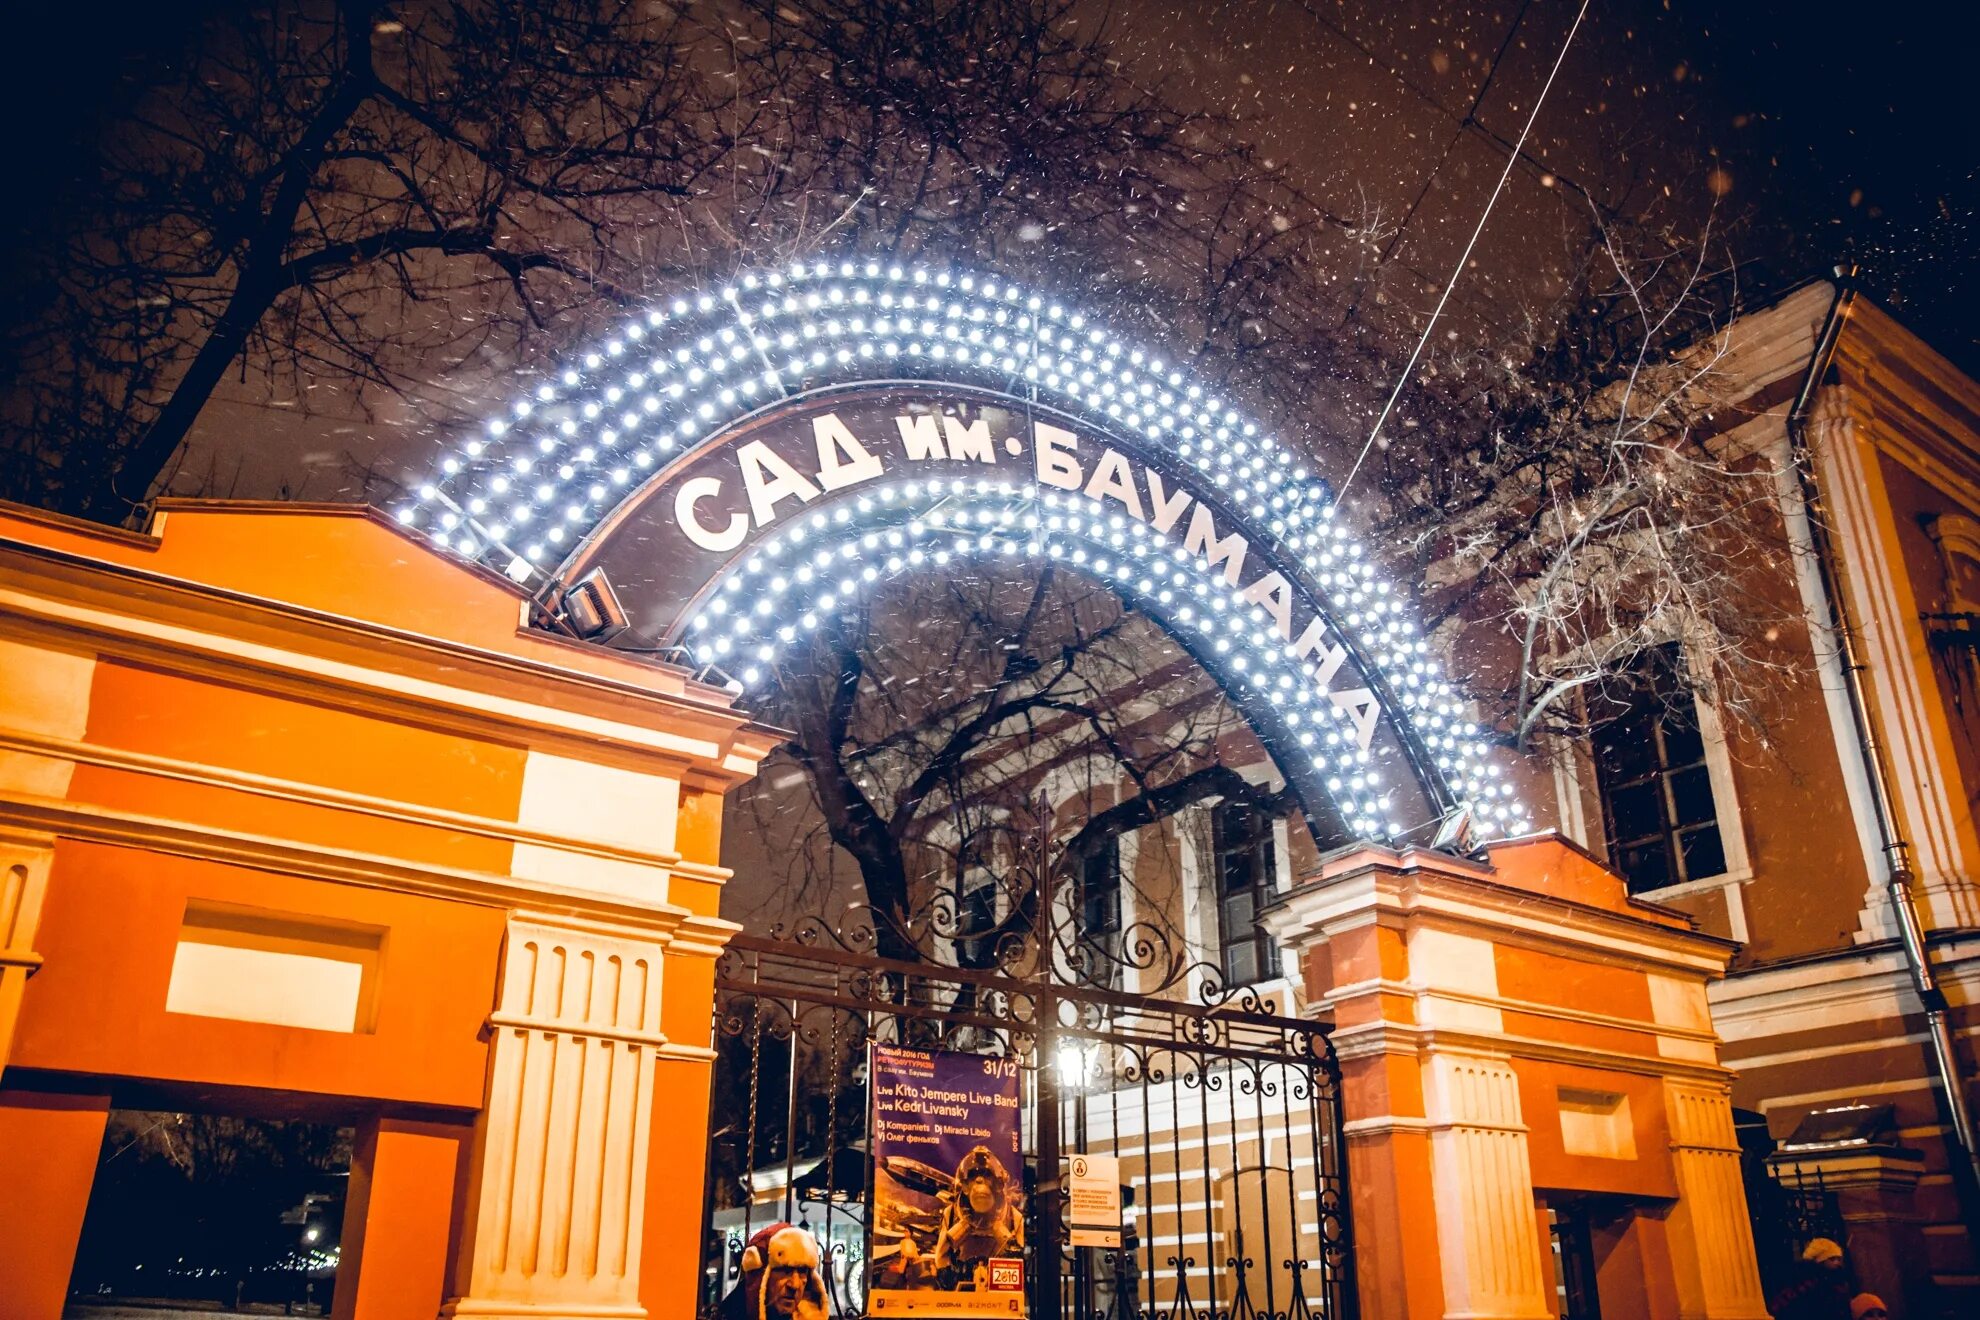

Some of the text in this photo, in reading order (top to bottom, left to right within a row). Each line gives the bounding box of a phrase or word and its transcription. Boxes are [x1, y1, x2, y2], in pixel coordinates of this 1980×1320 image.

[674, 412, 884, 552] САД
[1033, 421, 1381, 751] БАУМАНА
[917, 1052, 930, 1060] ГОД
[983, 1058, 1017, 1079] 31/12
[877, 1083, 1018, 1108] Live Kito Jempere Live Band
[877, 1098, 969, 1120] Live Kedr Livansky
[877, 1119, 991, 1138] Dj Kompaniets Dj Miracle Libido
[886, 1132, 905, 1142] Олег
